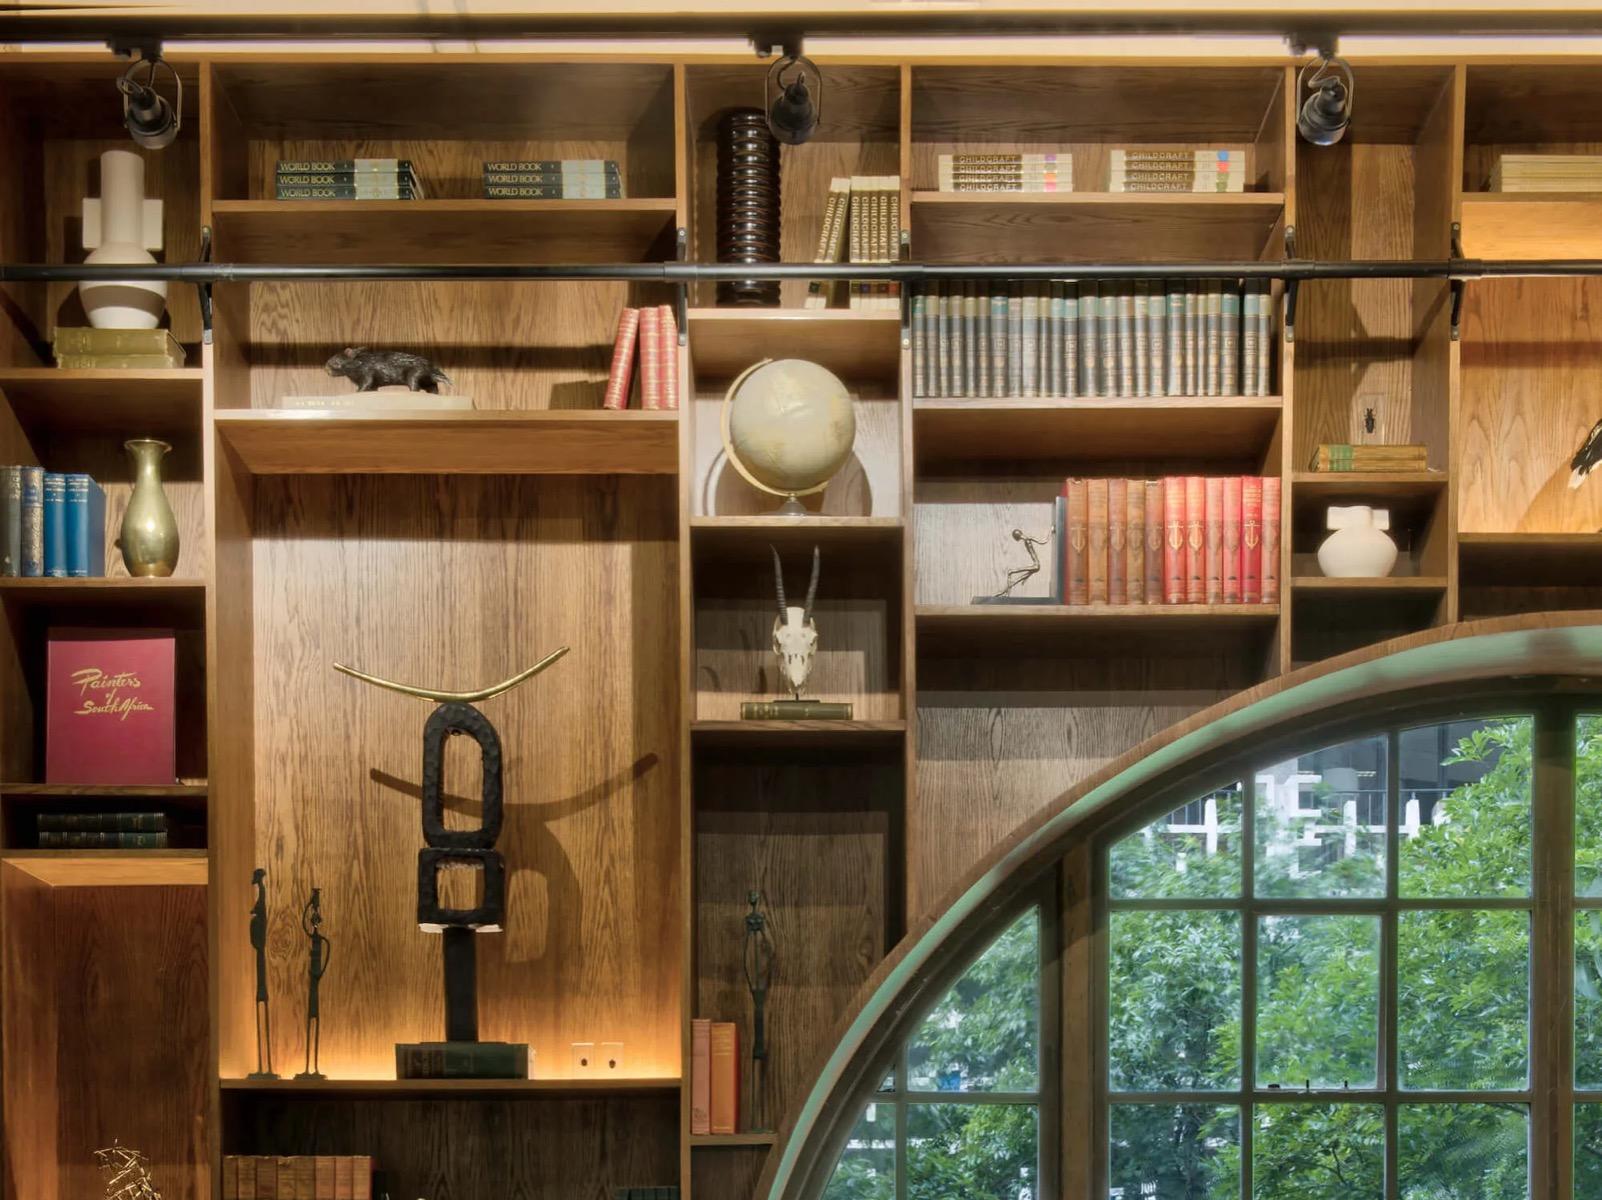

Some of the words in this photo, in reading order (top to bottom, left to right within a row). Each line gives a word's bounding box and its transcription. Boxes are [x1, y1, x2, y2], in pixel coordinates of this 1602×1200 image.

[1132, 152, 1188, 160] CHILDCRAFT
[280, 162, 310, 170] WORLD
[312, 162, 335, 170] BOOK
[1131, 162, 1188, 170] CHILDCRAFT
[280, 176, 310, 184] WORLD
[311, 176, 335, 184] BOOK
[488, 175, 518, 183] WORLD
[520, 175, 543, 183] BOOK
[960, 174, 1016, 182] CHILDCRAFT
[281, 189, 310, 197] WORLD
[312, 189, 336, 197] BOOK
[488, 188, 518, 196] WORLD
[519, 188, 544, 196] BOOK
[818, 197, 836, 255] CHILDCRAFT
[828, 198, 846, 256] CHILDCRAFT
[852, 196, 860, 254] CHILDCRAFT
[880, 196, 888, 254] CHILDCRAFT
[890, 196, 898, 255] CHILDCRAFT
[71, 668, 141, 696] Painters
[105, 688, 118, 705] of
[73, 697, 119, 715] South
[118, 696, 155, 721] Africa
